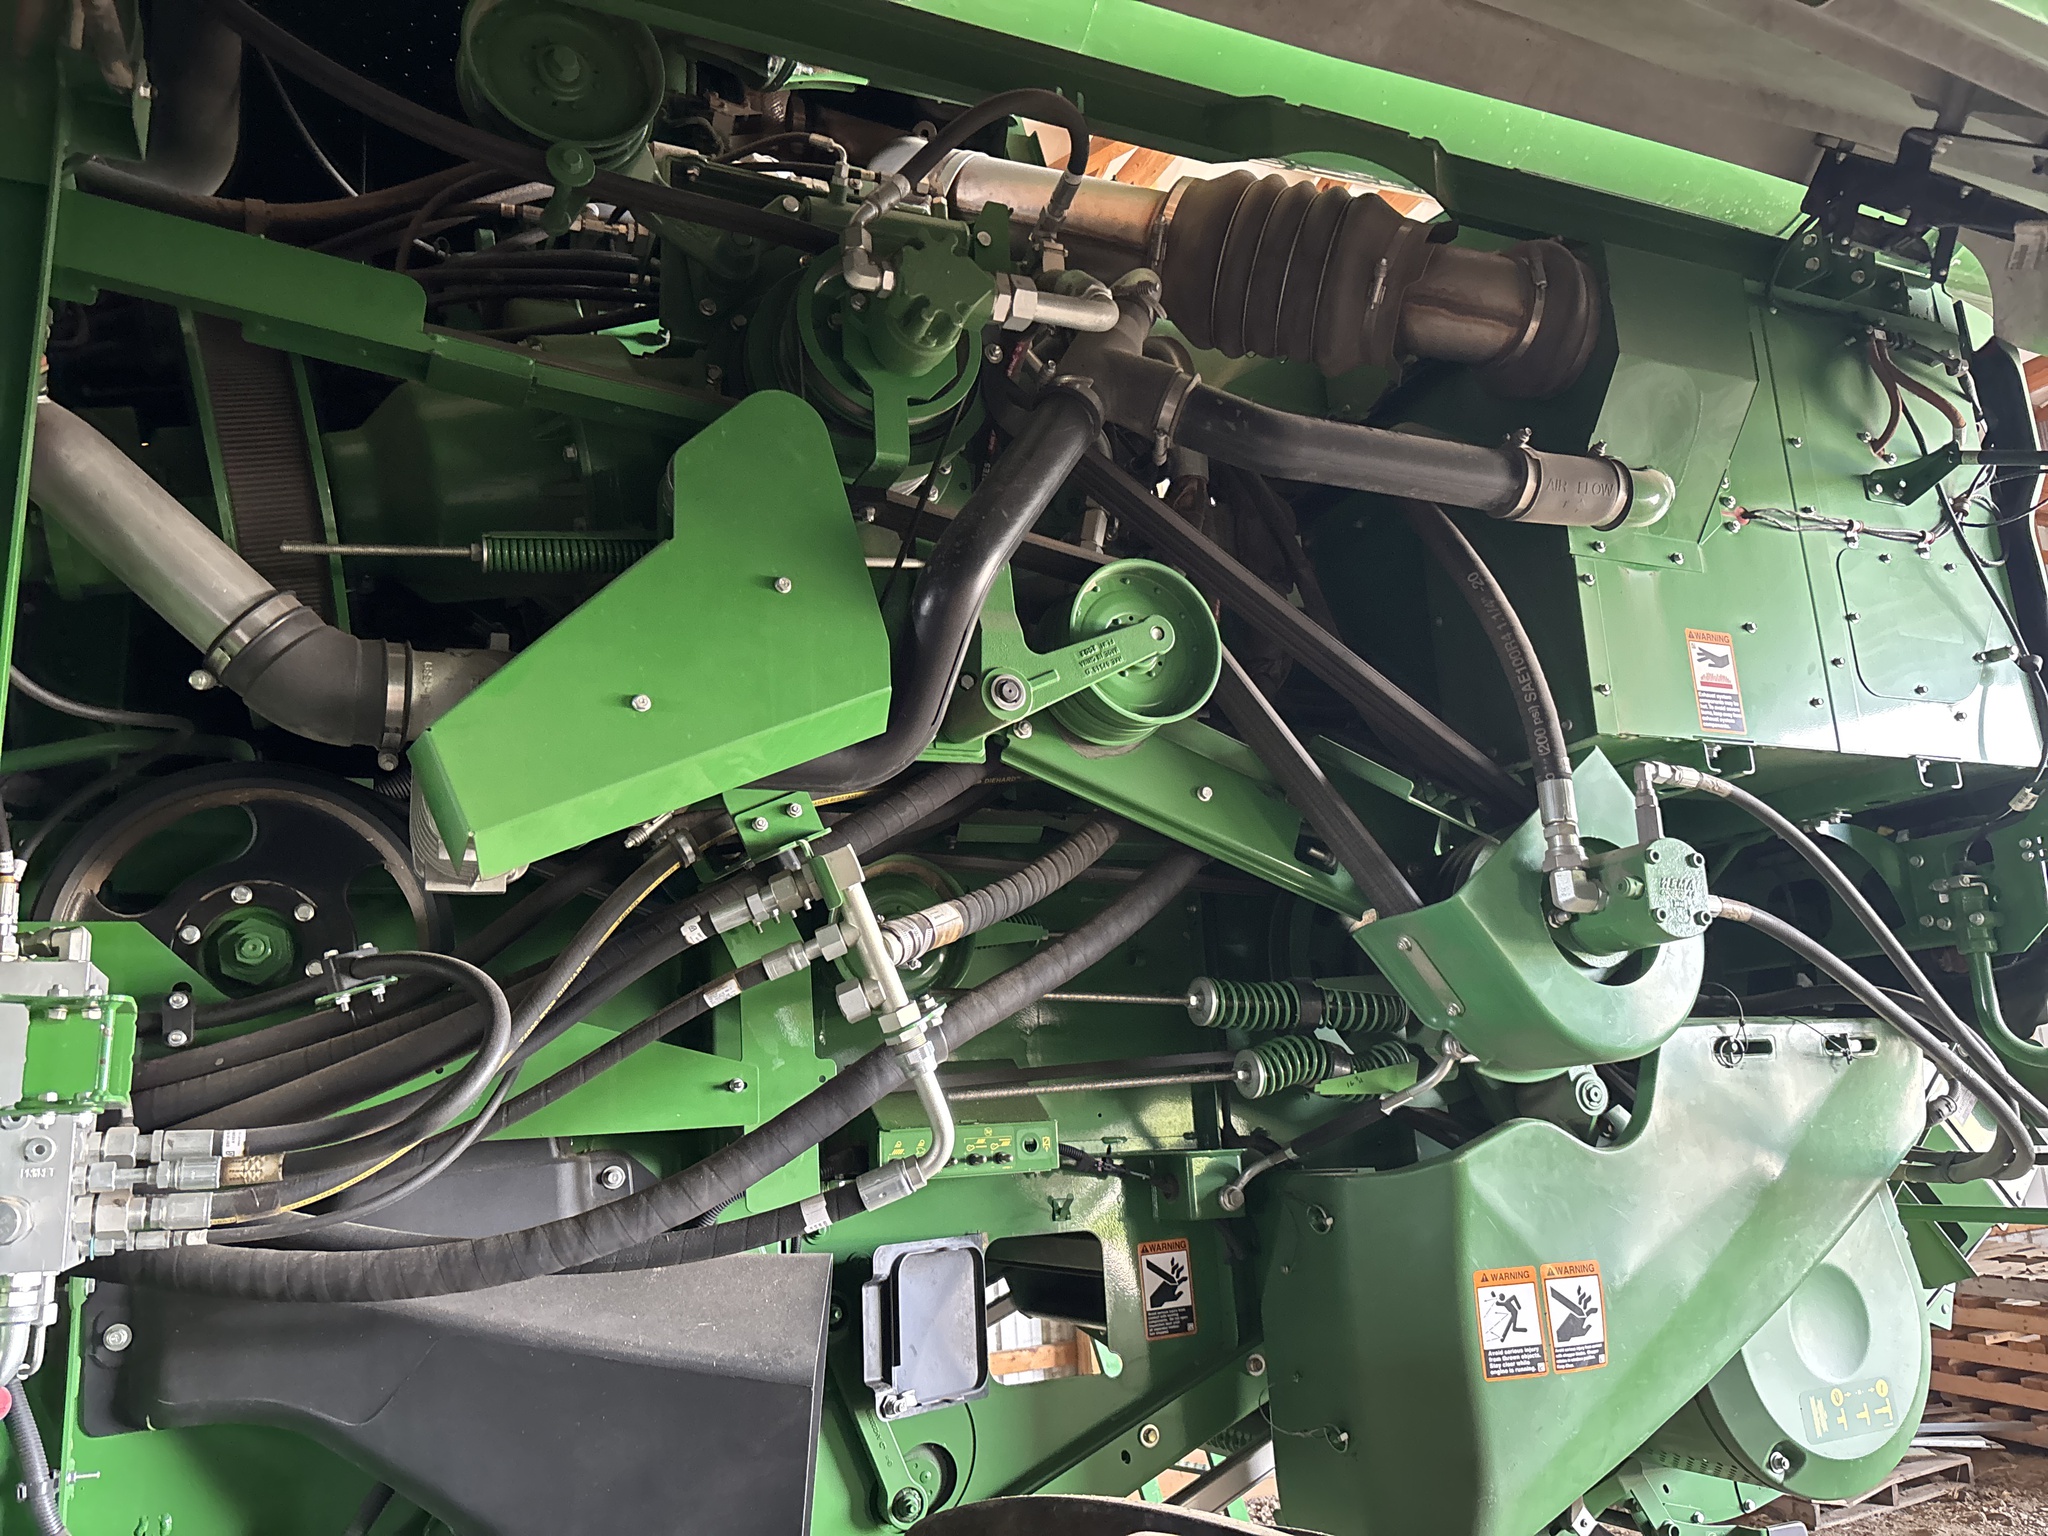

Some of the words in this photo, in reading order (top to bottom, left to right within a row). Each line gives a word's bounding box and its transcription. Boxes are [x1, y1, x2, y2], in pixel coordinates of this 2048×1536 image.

[1546, 478, 1567, 493] AIR
[1694, 631, 1730, 643] WARNING
[1500, 630, 1537, 703] SAE100R4
[1527, 704, 1543, 726] psi)
[1149, 1240, 1186, 1252] WARNING
[1555, 1263, 1595, 1275] WARNING
[1490, 1270, 1530, 1282] WARNING
